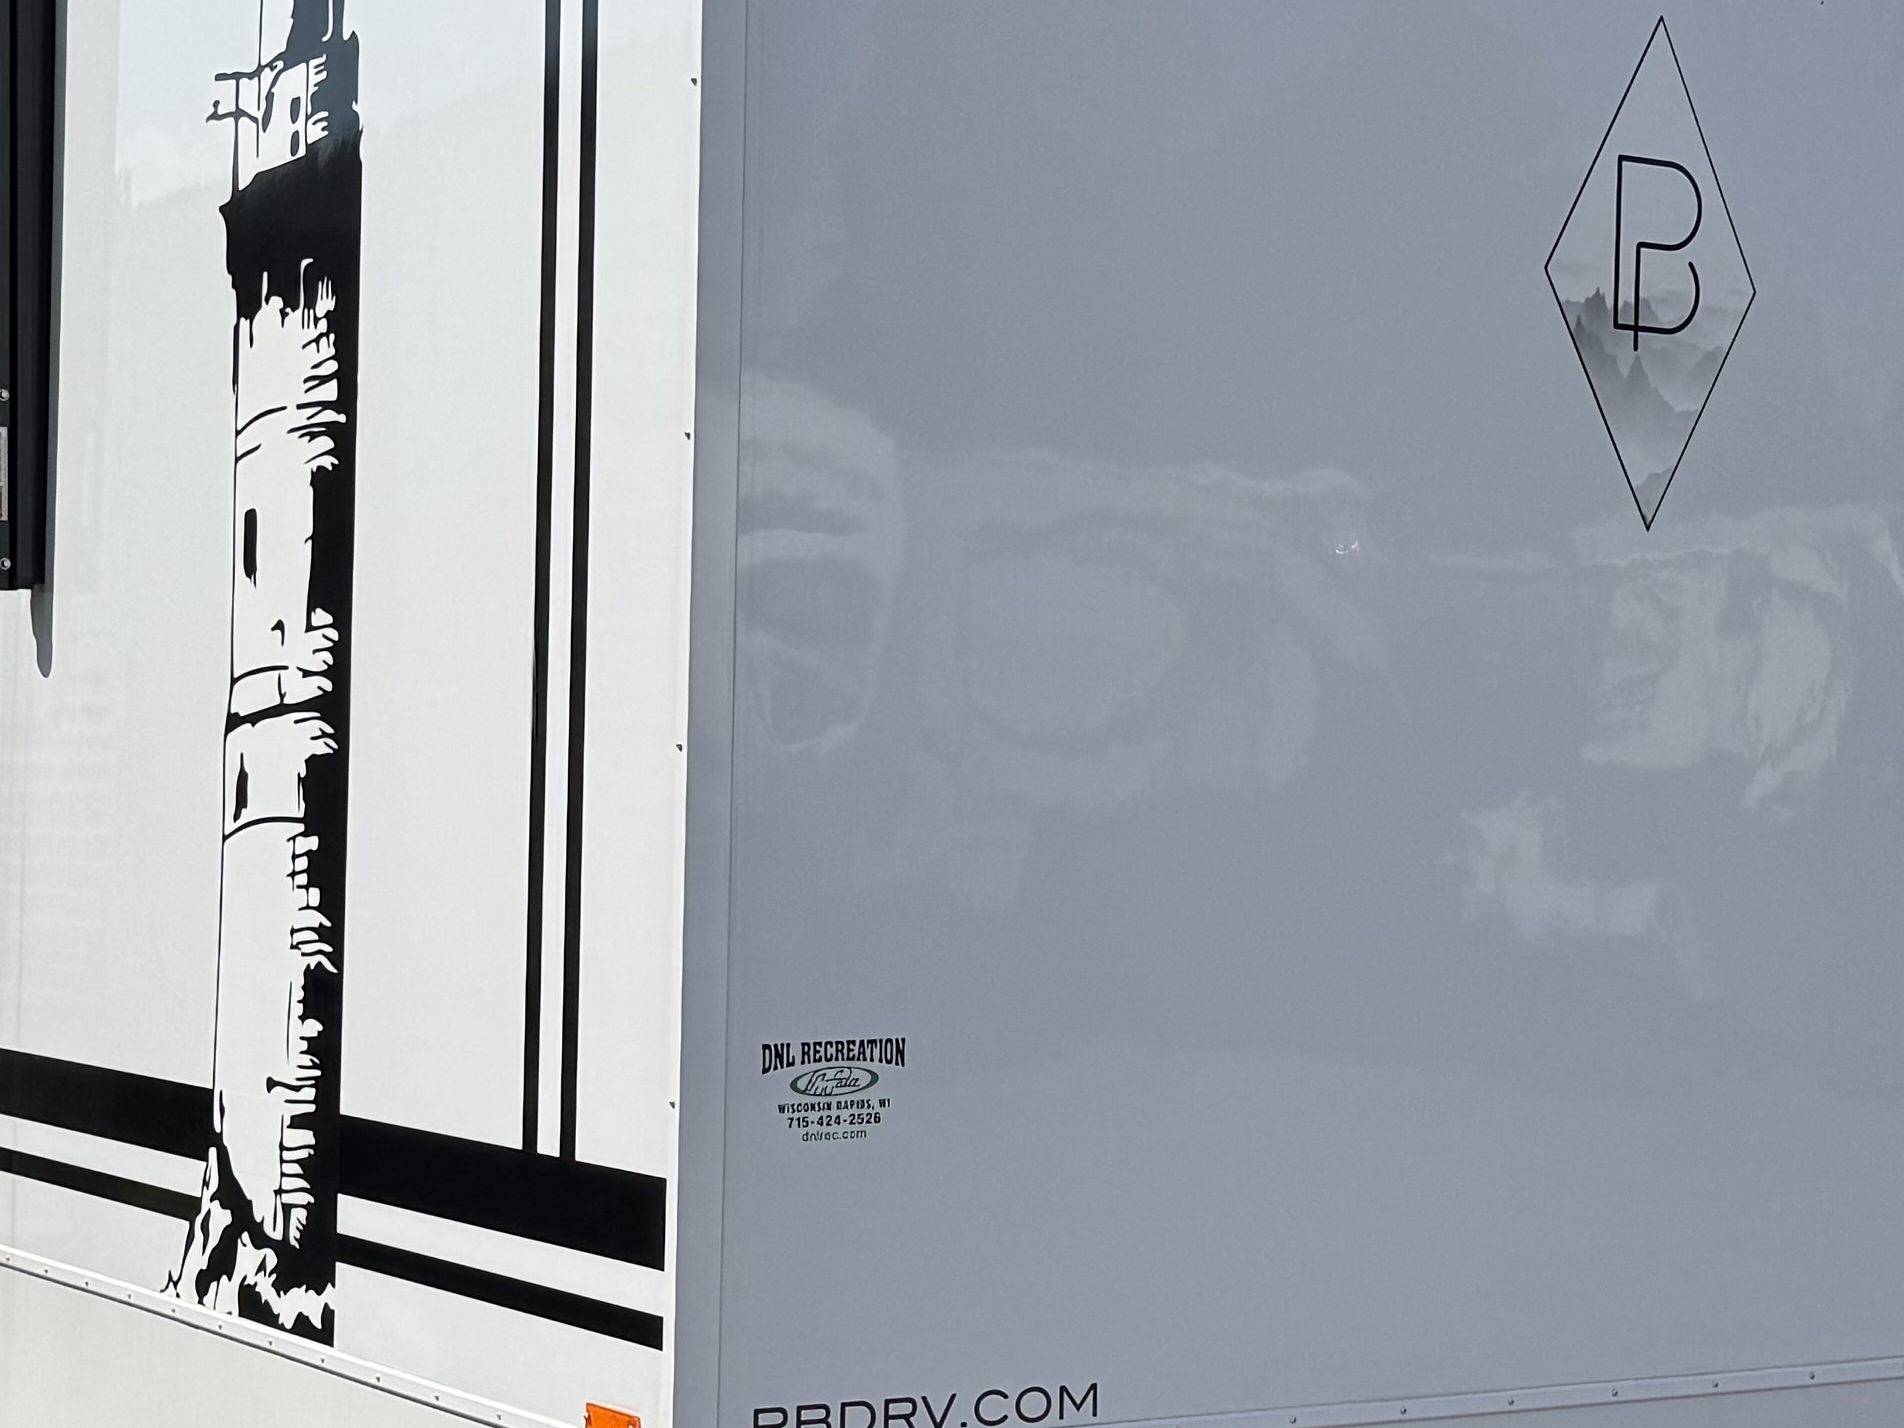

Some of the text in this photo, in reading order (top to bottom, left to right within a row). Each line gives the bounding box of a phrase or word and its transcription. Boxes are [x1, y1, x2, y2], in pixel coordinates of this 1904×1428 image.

[761, 1037, 906, 1075] DNL RECREATION
[778, 1102, 832, 1114] WISCONSIN
[878, 1098, 891, 1109] WI
